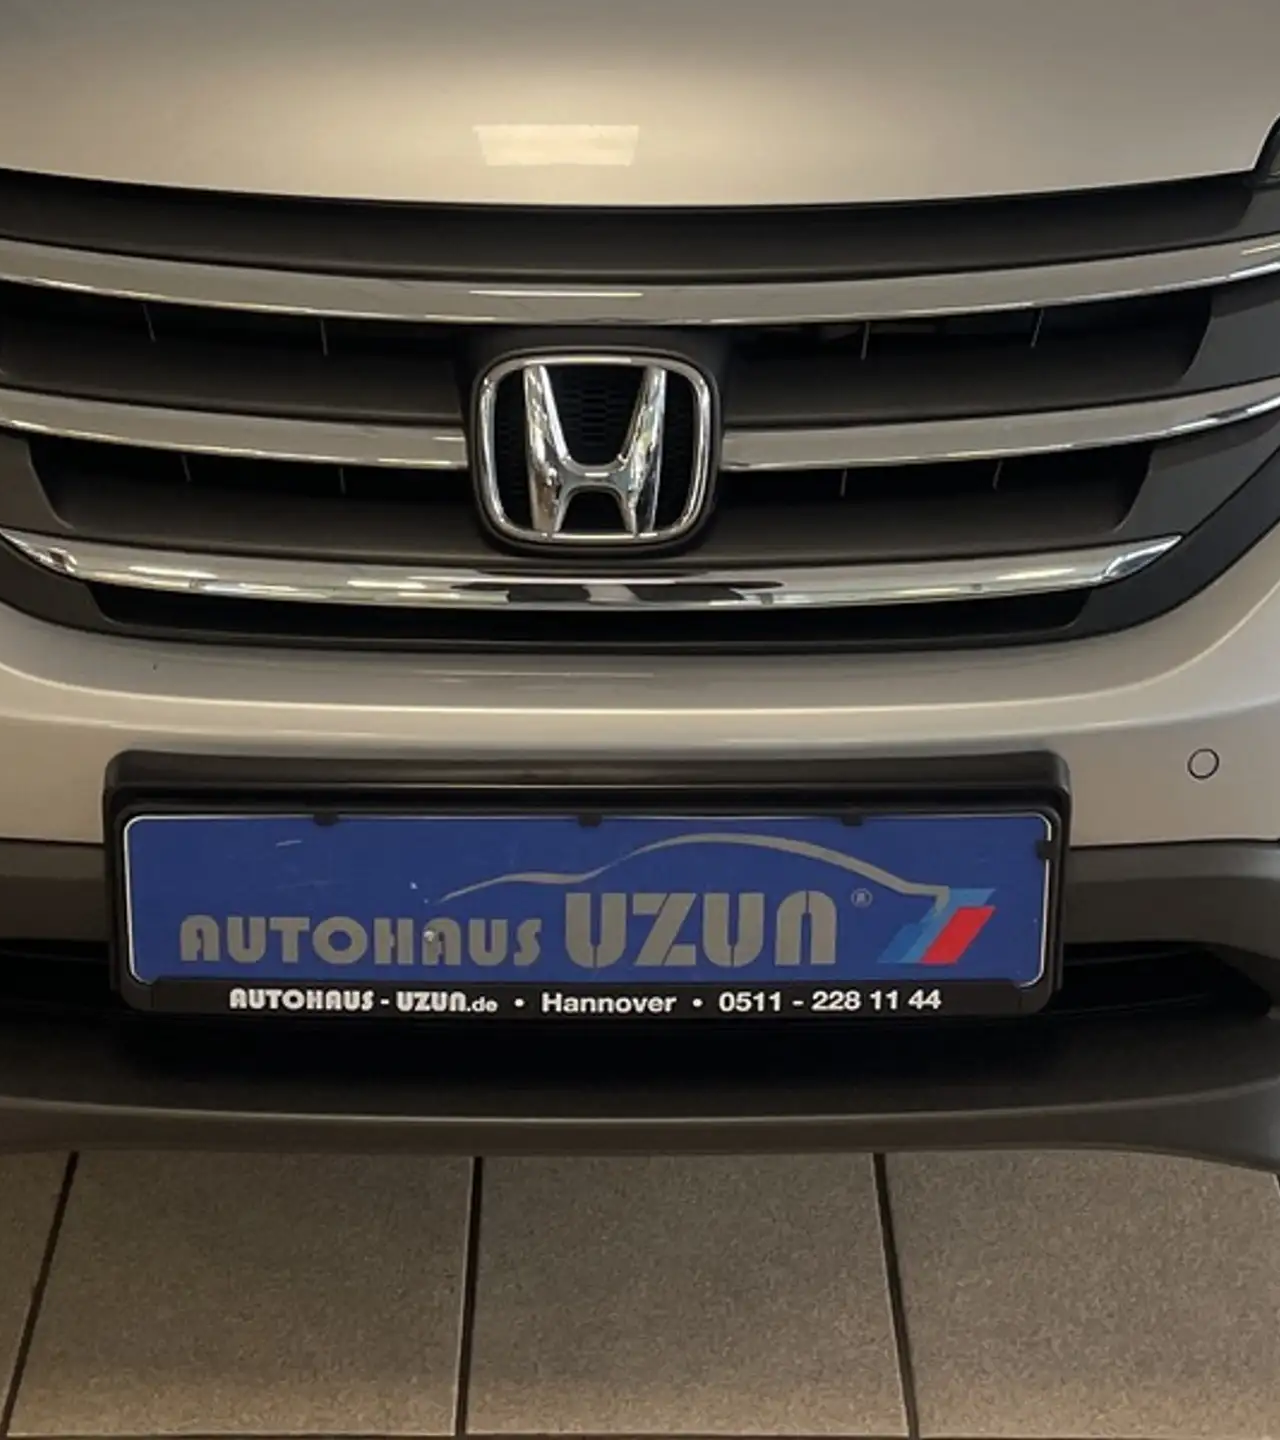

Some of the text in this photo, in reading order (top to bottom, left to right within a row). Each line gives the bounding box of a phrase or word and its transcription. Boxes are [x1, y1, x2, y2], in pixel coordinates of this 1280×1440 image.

[179, 889, 837, 969] AUTOHAUS UZUN
[228, 987, 375, 1011] AUTOHAUS
[395, 990, 499, 1014] UZUN.de
[540, 991, 678, 1014] Hannover
[718, 991, 782, 1012] 0511
[810, 989, 862, 1011] 228
[869, 989, 898, 1010] 11
[907, 988, 943, 1010] 44
